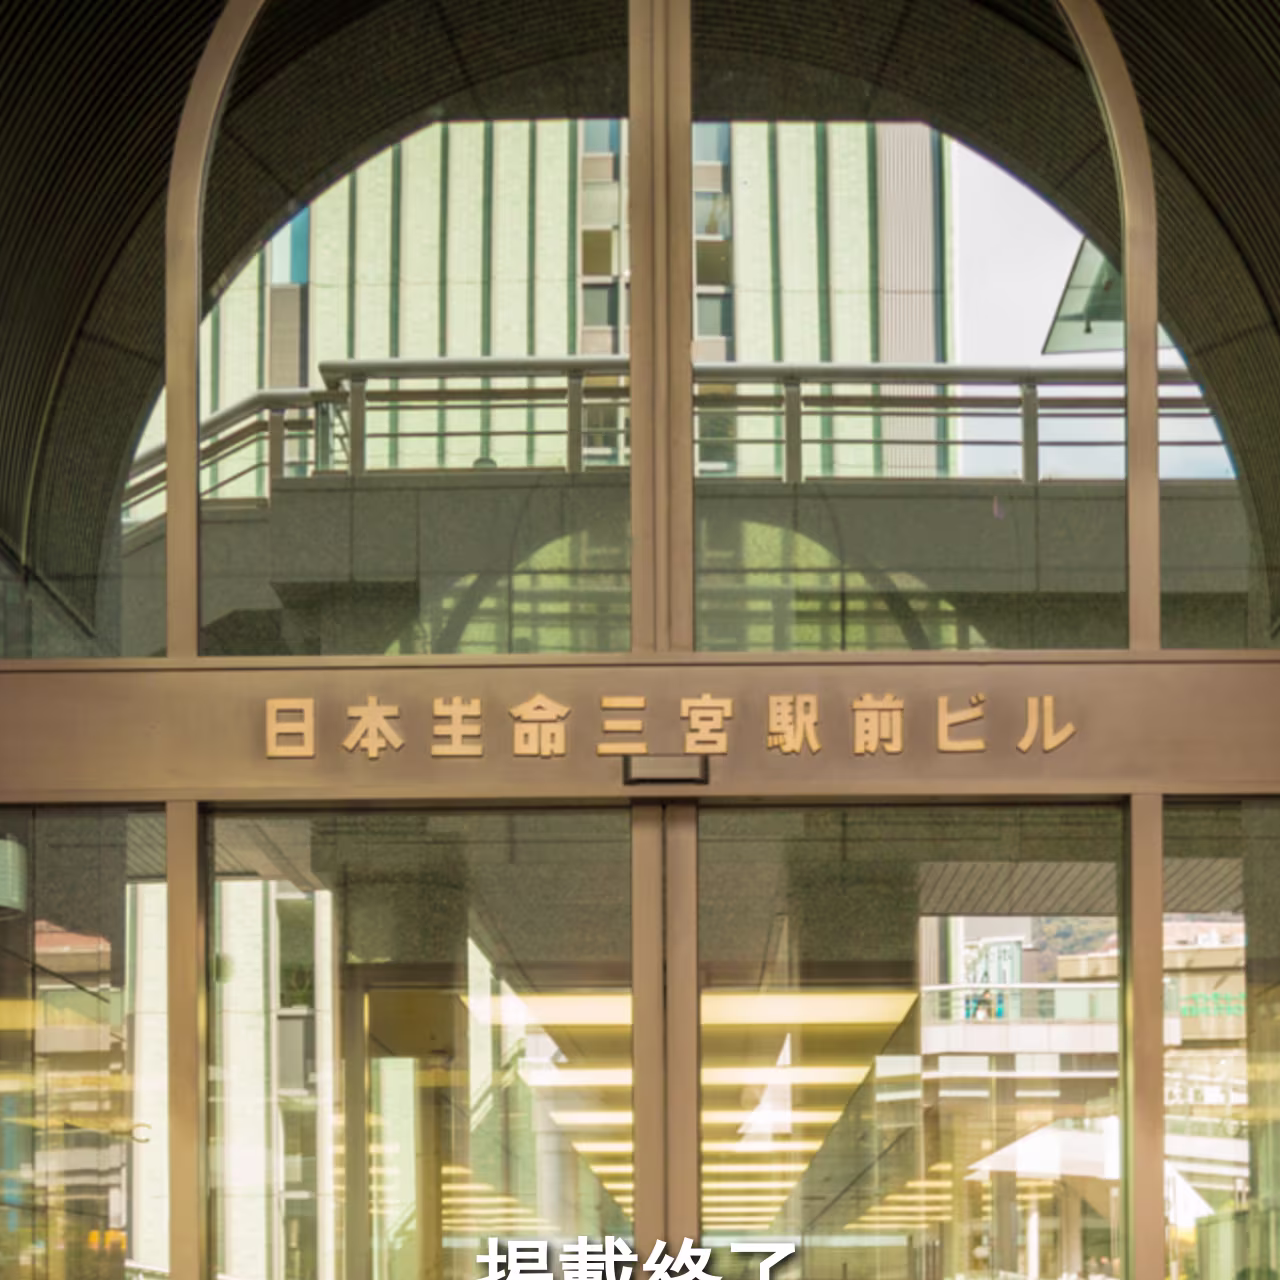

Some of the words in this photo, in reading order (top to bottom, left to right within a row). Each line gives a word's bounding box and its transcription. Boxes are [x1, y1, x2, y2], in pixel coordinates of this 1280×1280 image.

[264, 693, 1077, 758] 日本生命三宮駅前ビル
